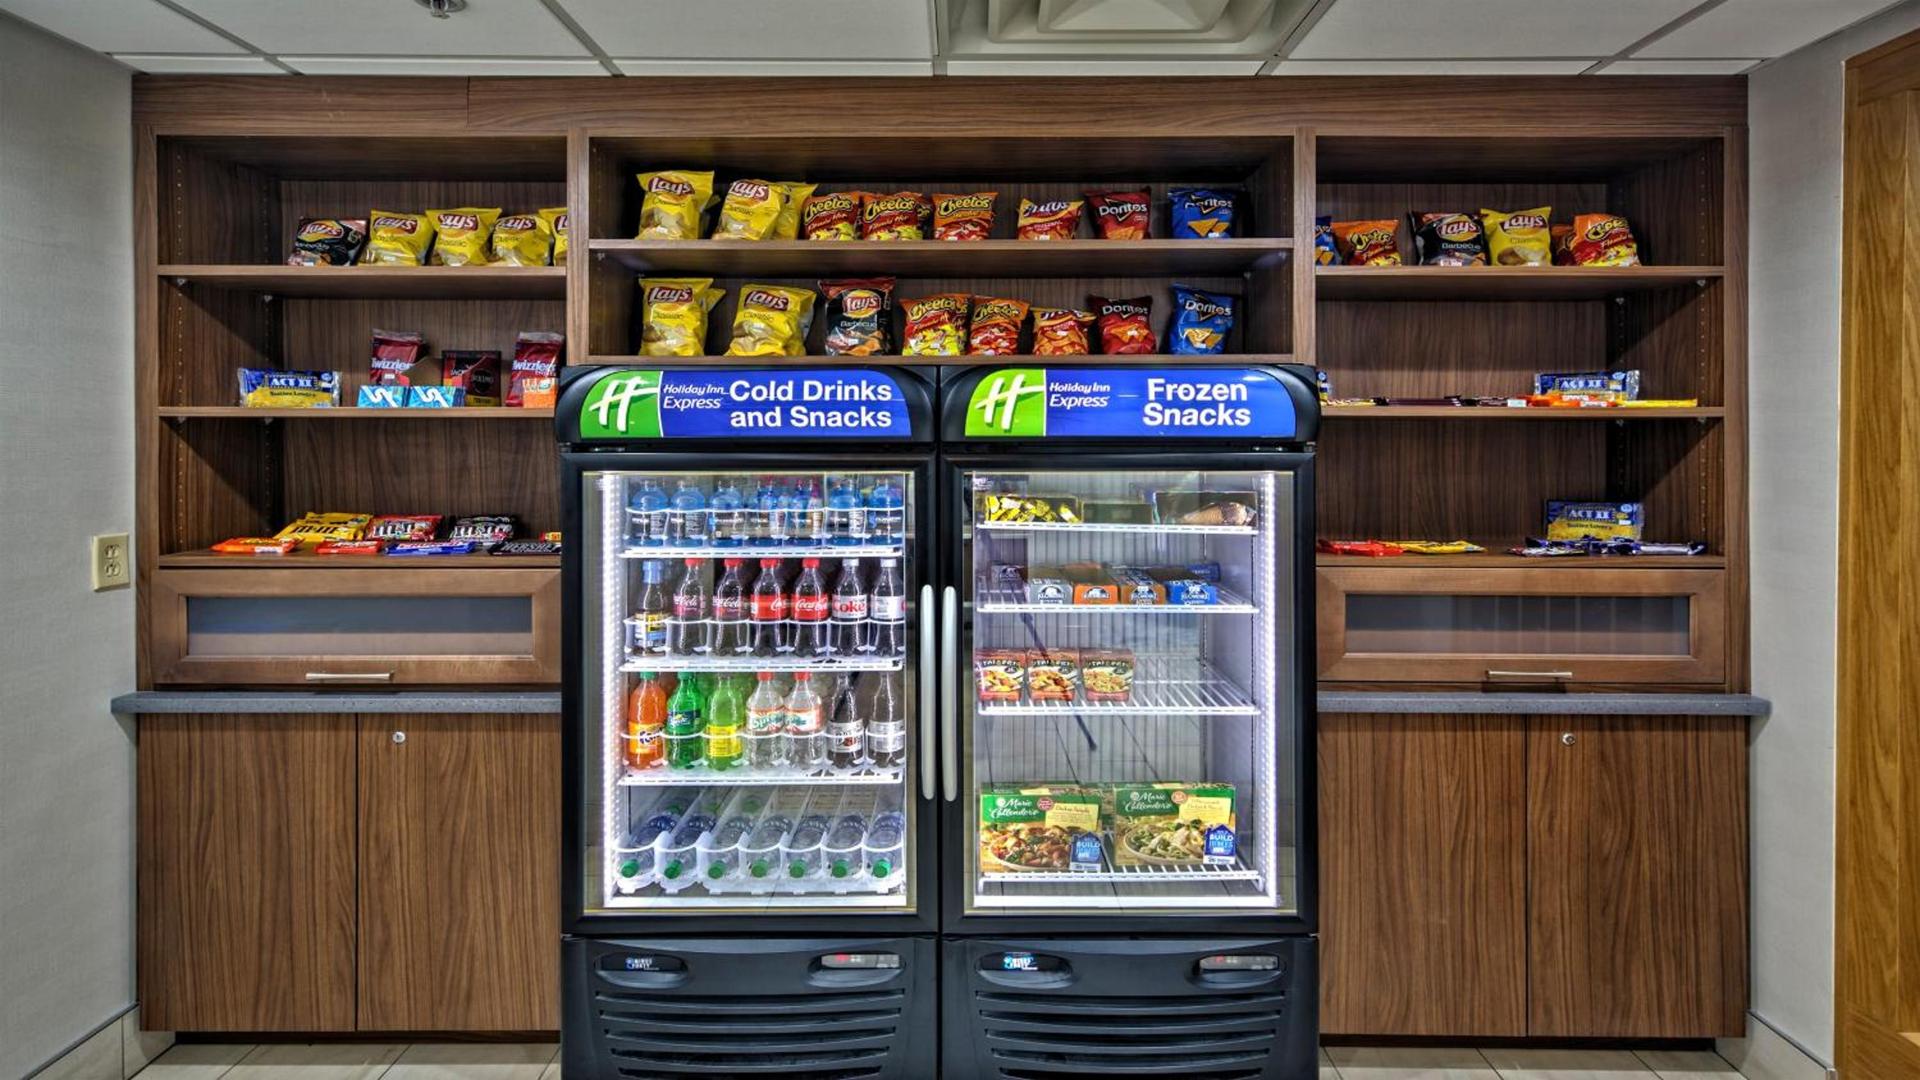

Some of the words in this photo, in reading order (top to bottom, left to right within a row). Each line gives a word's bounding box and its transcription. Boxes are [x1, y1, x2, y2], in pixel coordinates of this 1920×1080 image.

[804, 198, 851, 224] Cheetos
[865, 198, 915, 223] Cheetos
[939, 196, 990, 216] Cheetos
[1099, 203, 1148, 216] Doritos
[1102, 304, 1148, 315] Doritos
[1184, 299, 1232, 316] Doritos
[270, 378, 297, 386] ACT
[1049, 382, 1091, 394] Holiday
[1091, 383, 1111, 393] Inn
[663, 383, 705, 396] Holiday
[705, 384, 724, 394] Inn
[729, 379, 795, 402] Cold
[803, 379, 892, 402] Drinks
[1146, 378, 1248, 402] Frozen
[663, 396, 721, 411] Express
[1049, 394, 1110, 408] Express
[729, 405, 782, 427] and
[790, 405, 892, 427] Snacks
[1142, 402, 1252, 427] Snacks
[1568, 509, 1593, 518] ACT
[1595, 509, 1610, 519] II
[1004, 798, 1033, 808] Marie
[1138, 792, 1166, 802] Marie
[1209, 833, 1234, 841] BUILD
